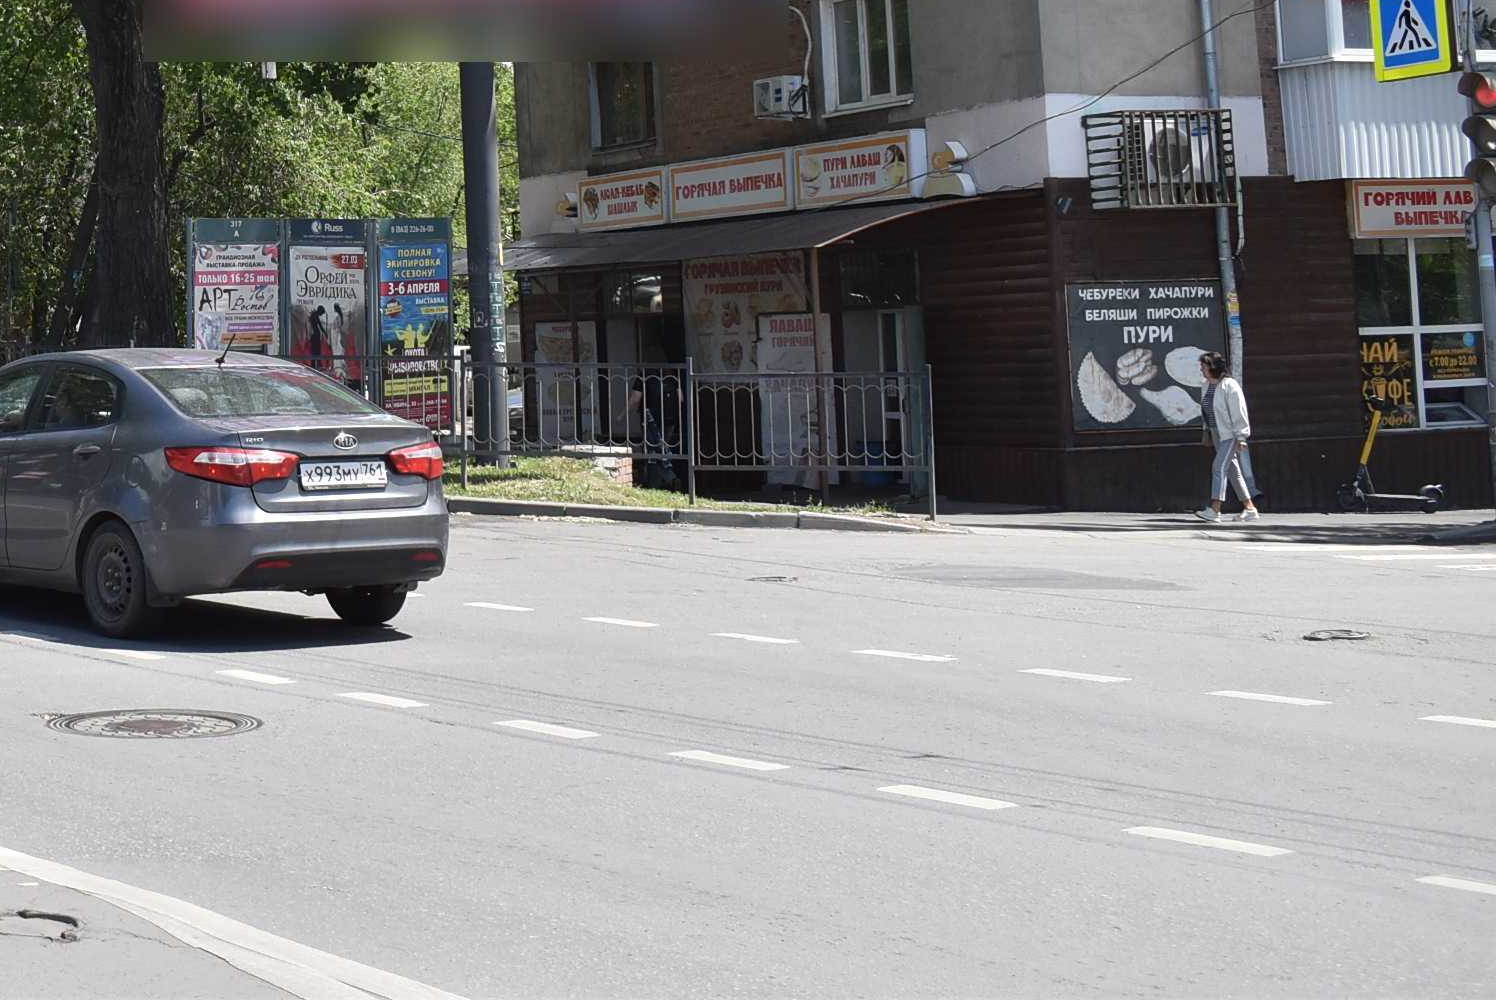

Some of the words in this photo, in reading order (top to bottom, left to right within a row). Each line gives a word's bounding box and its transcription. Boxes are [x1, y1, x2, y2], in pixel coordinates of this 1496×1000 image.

[823, 156, 848, 173] ПУРИ
[850, 152, 881, 168] ЛАВАШ
[676, 180, 726, 201] ГОРЯЧАЯ
[729, 173, 783, 194] ВЫПЕЧКА
[829, 171, 876, 190] ХАЧАПУРИ
[1364, 188, 1437, 206] ГОРЯЧИЙ
[1443, 190, 1474, 206] ЛАВ
[325, 223, 344, 232] Russ
[398, 248, 432, 257] ПОЛНАЯ
[386, 259, 441, 268] ЭКИПИРОВКА
[198, 274, 227, 284] ТОЛЬКО
[231, 273, 255, 283] 16-25
[401, 270, 435, 278] СЕЗОНУ!
[296, 280, 357, 299] ЭВРИДИКА
[388, 282, 405, 295] 3-6
[407, 282, 440, 294] АПРЕЛЯ
[1078, 288, 1140, 300] ЧЕБУРЕКИ
[1149, 286, 1214, 299] ХАЧАПУРИ
[199, 287, 239, 311] АРТ
[1085, 309, 1137, 321] БЕЛЯШИ
[1146, 307, 1209, 320] ПИРОЖКИ
[1123, 325, 1173, 343] ПУРИ
